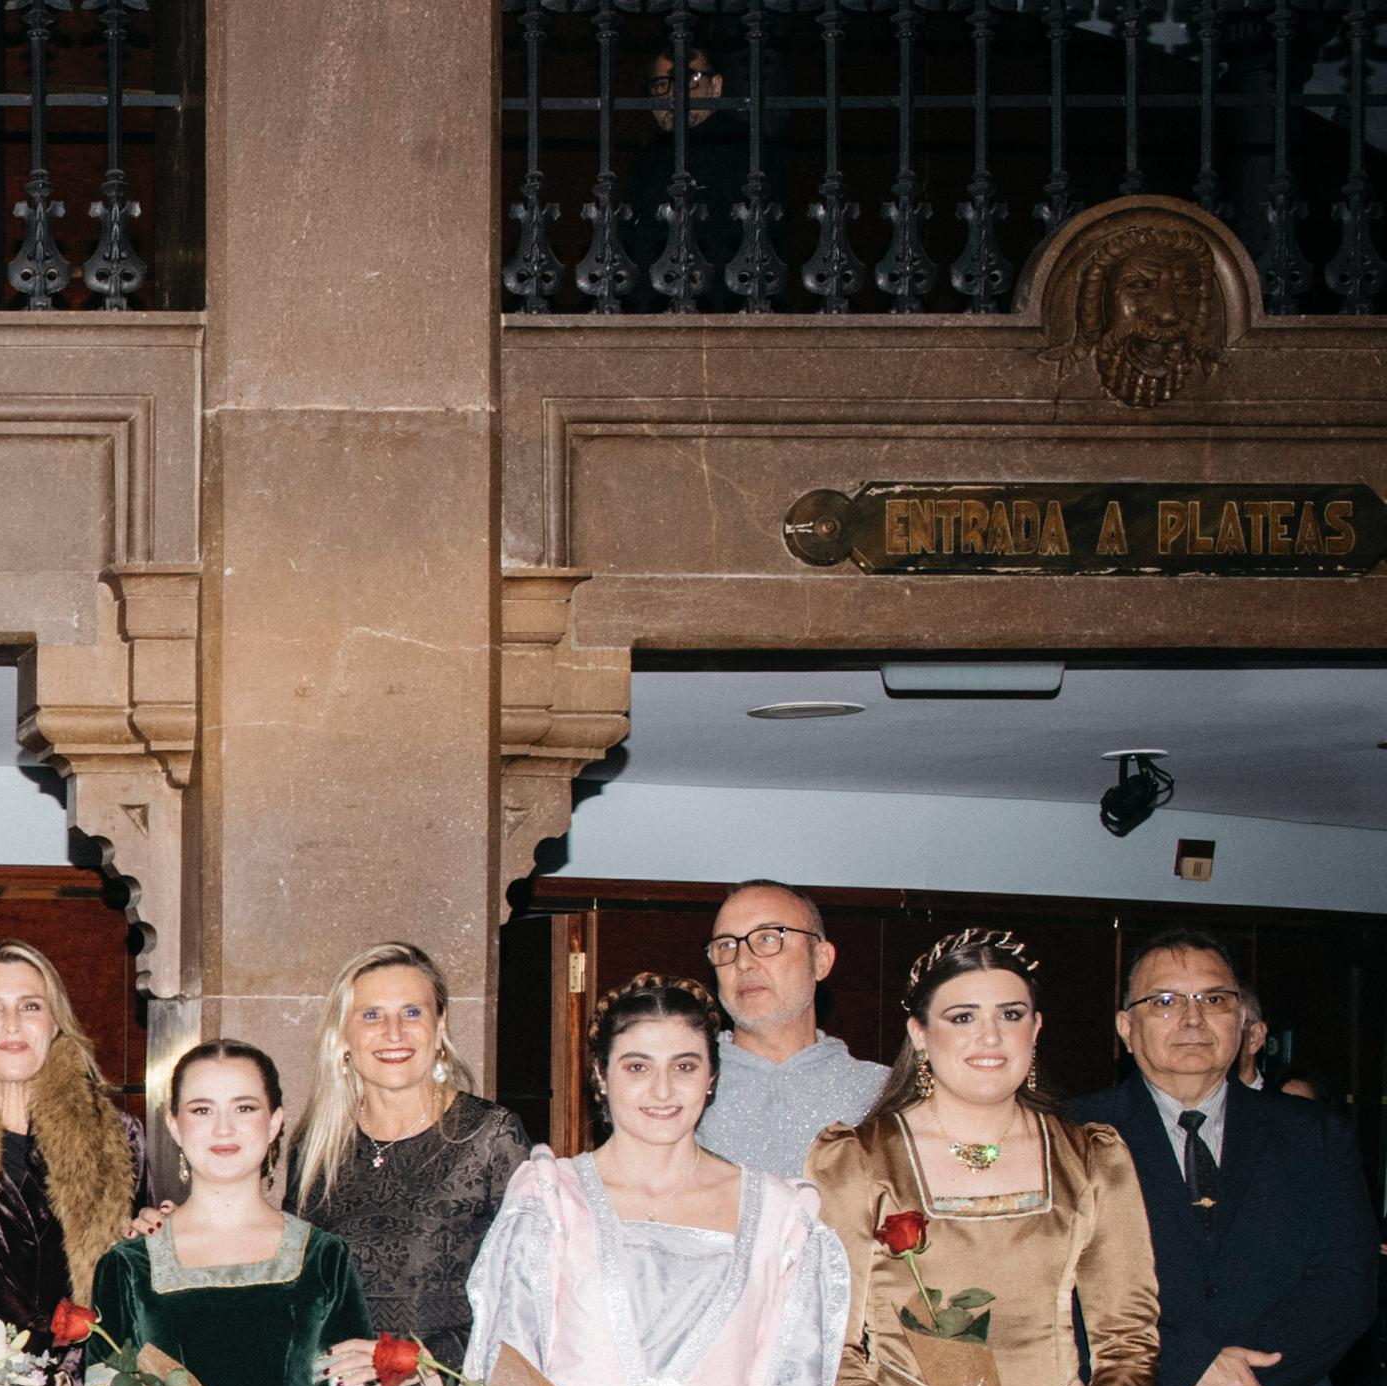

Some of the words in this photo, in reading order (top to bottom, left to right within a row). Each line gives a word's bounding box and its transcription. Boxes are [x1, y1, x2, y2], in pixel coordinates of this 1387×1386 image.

[885, 499, 1070, 555] ENTRADA
[1096, 501, 1128, 555] A
[1158, 500, 1356, 555] PLATEAS
